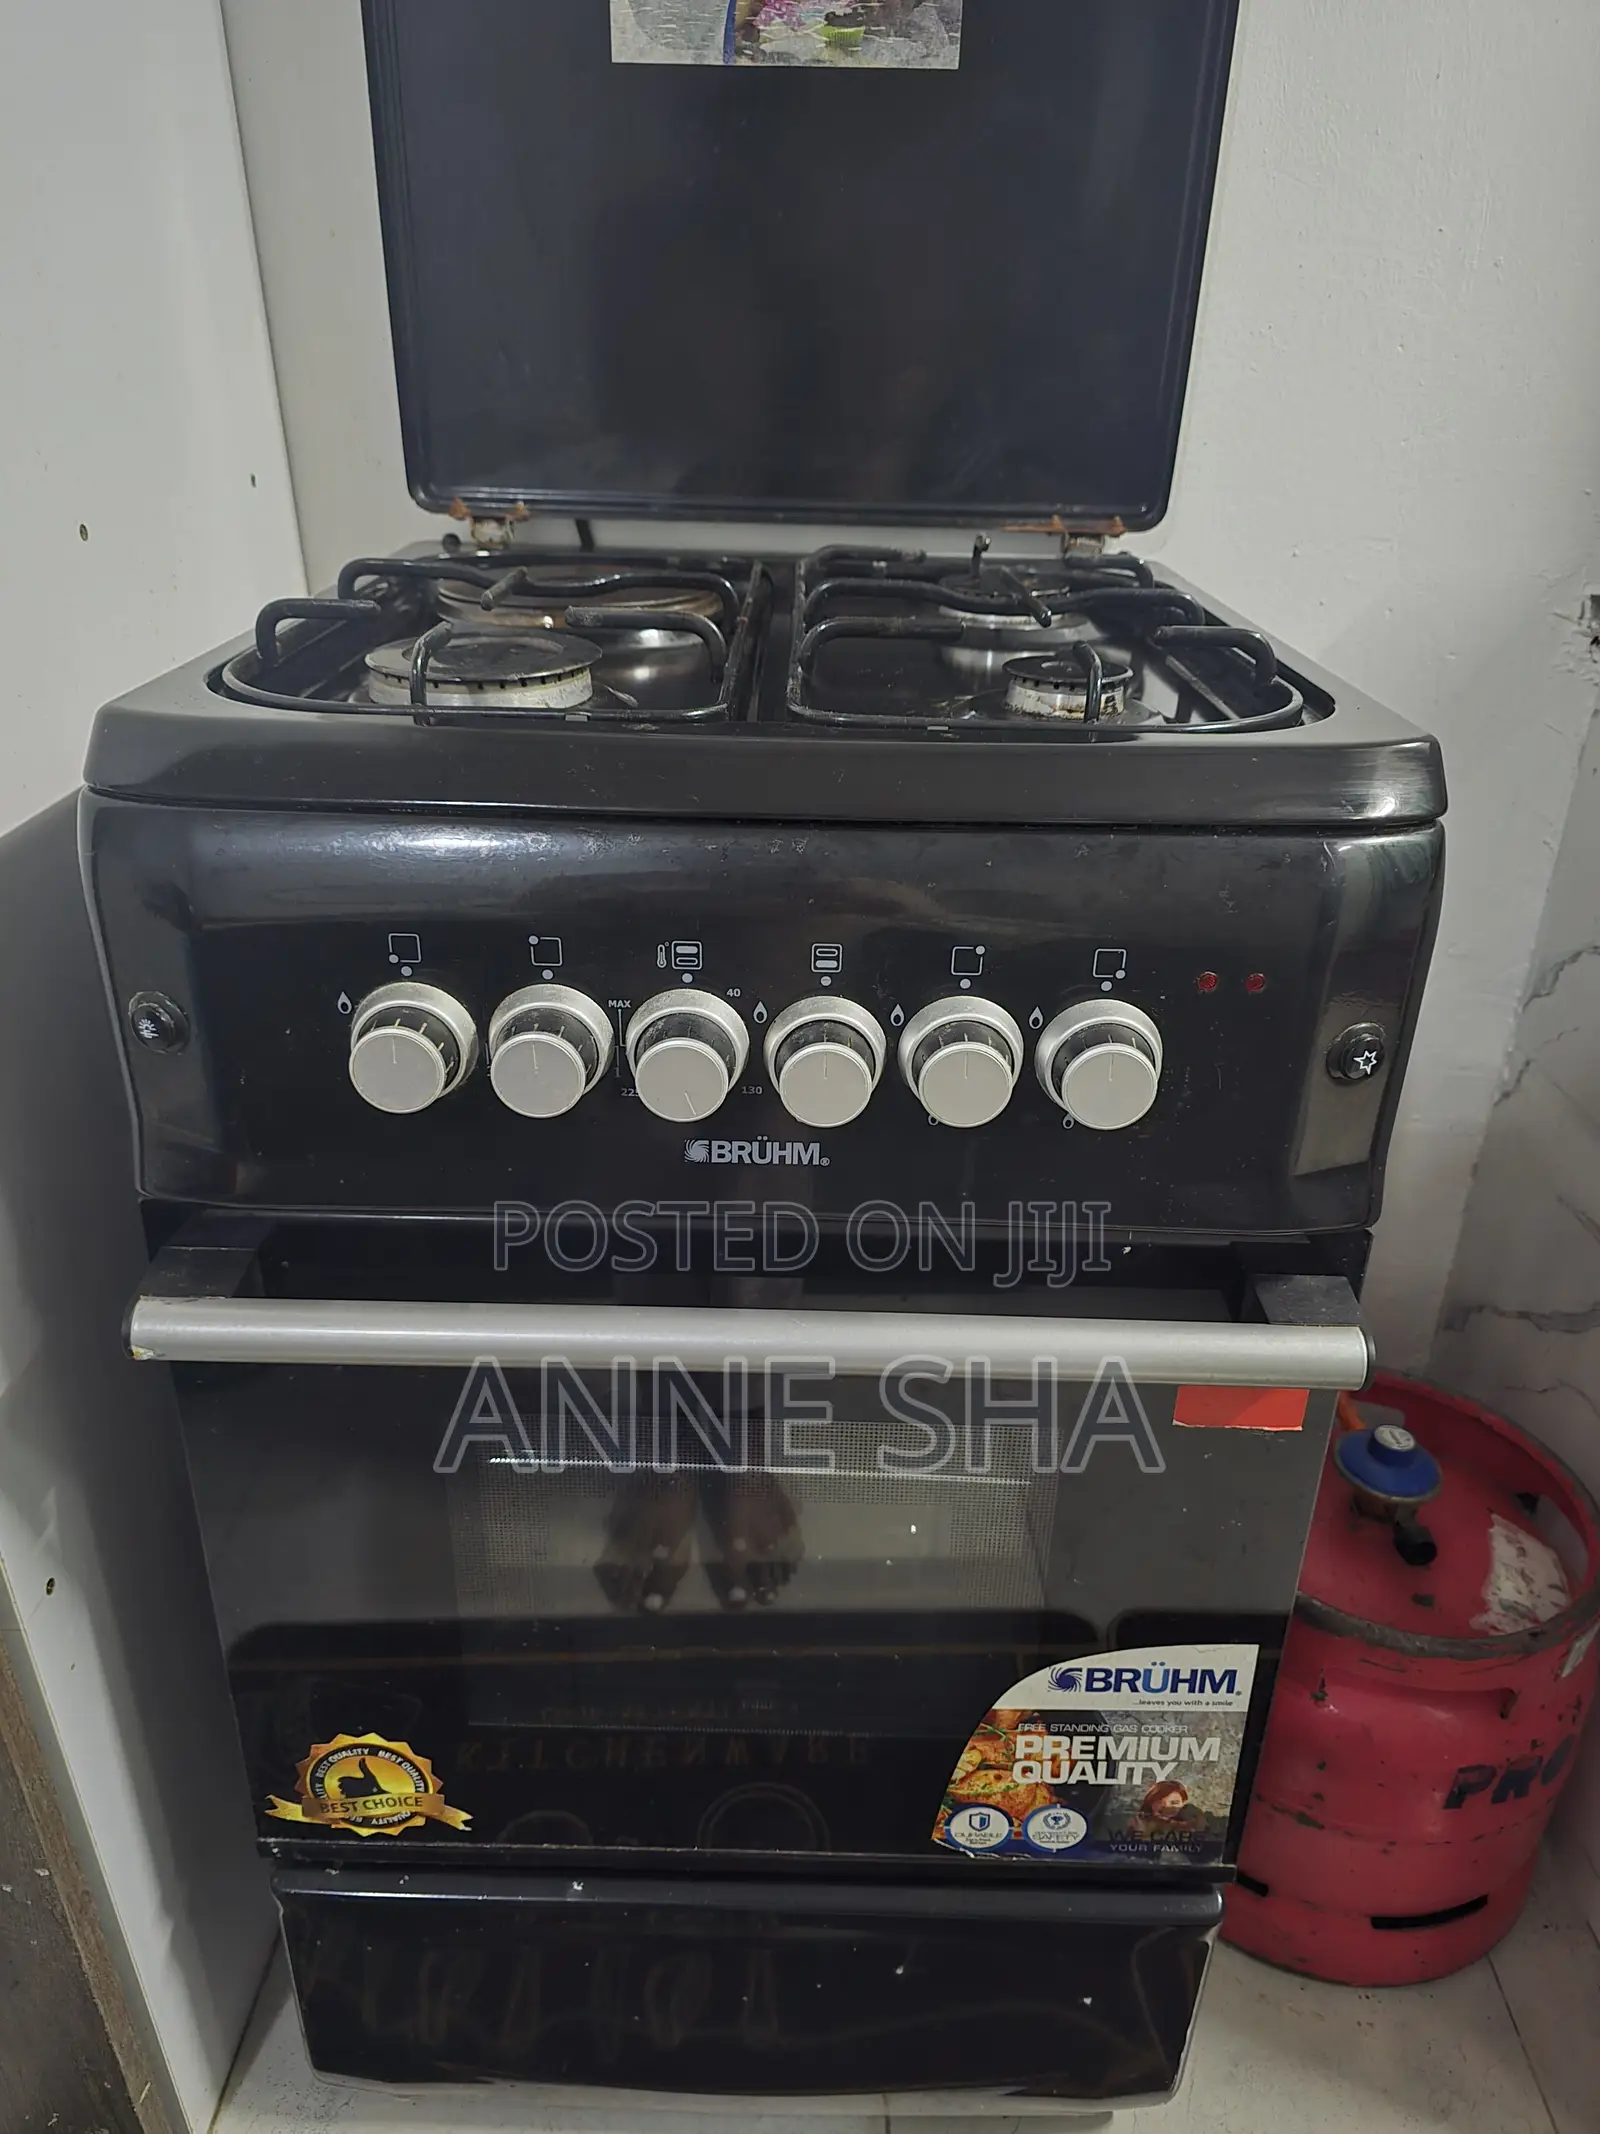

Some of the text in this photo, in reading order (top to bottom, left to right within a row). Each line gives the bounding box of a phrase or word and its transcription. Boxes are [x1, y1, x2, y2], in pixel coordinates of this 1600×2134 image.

[726, 988, 741, 997] 40
[608, 999, 631, 1009] MAX
[741, 1085, 763, 1095] 130
[1018, 1723, 1189, 1734] FREE STANDING GAS COOKER
[1015, 1735, 1221, 1762] PREMIUM
[315, 1748, 370, 1778] BEST QUALITY
[377, 1750, 425, 1793] BEST QUALITY
[1012, 1760, 1180, 1786] QUALITY
[321, 1796, 424, 1814] BEST CHOICE
[1110, 1843, 1148, 1852] YOUR
